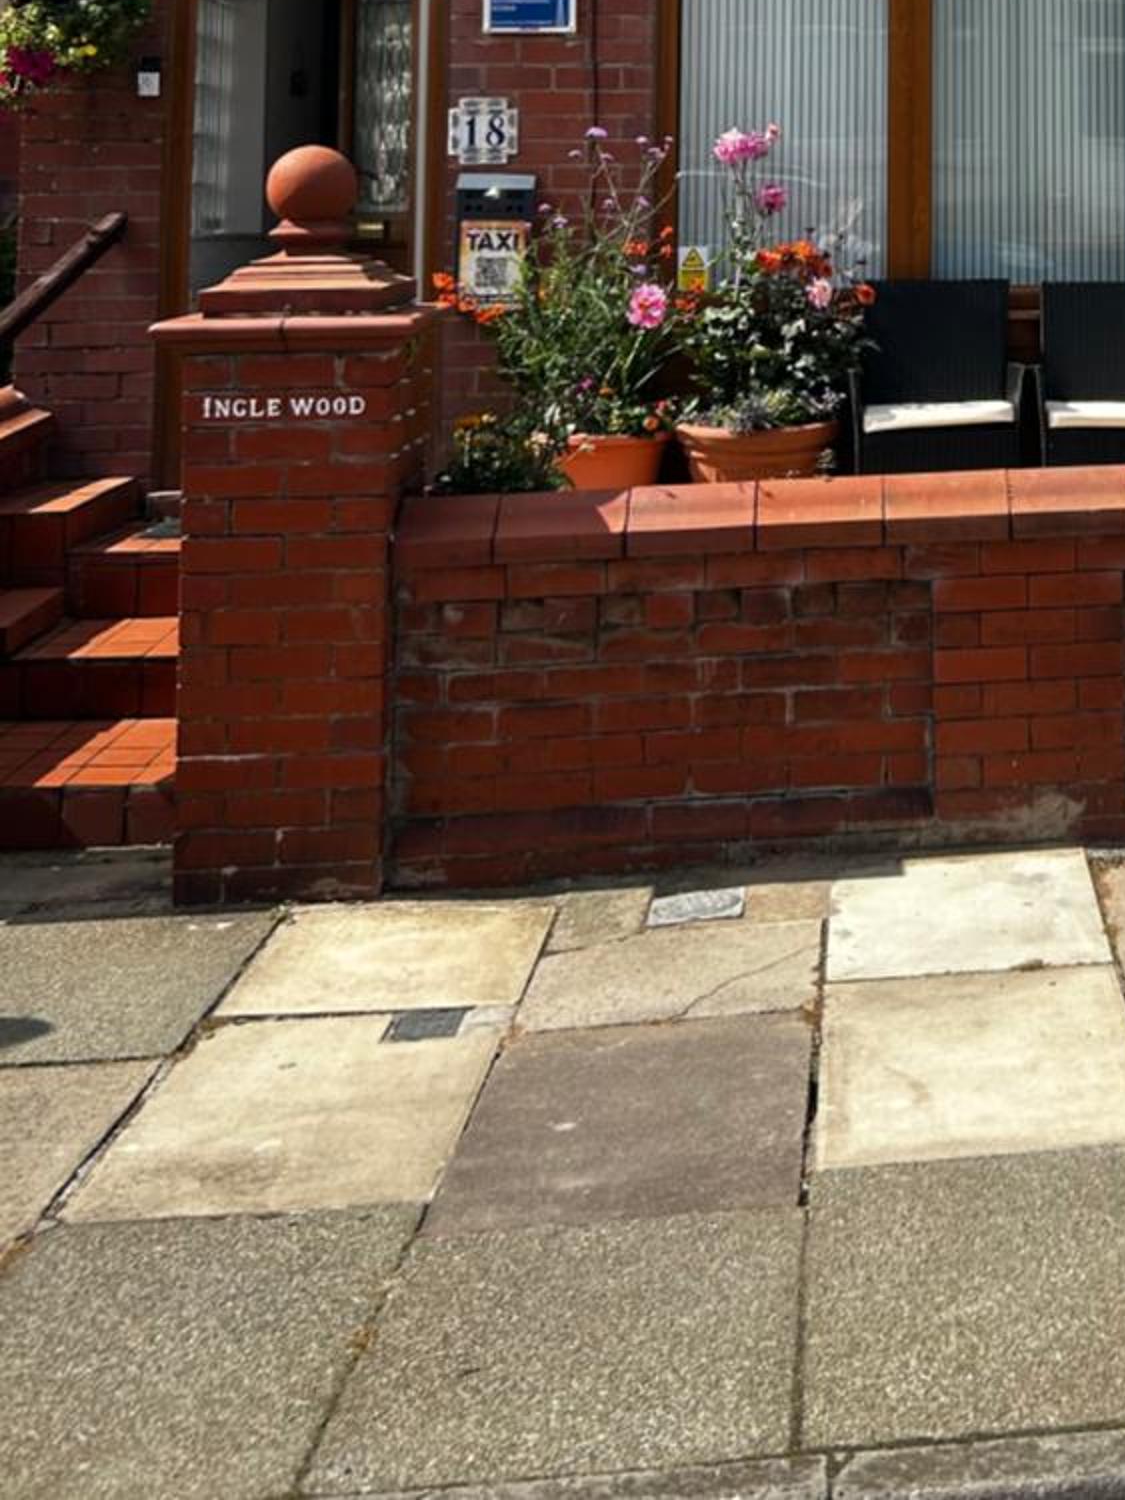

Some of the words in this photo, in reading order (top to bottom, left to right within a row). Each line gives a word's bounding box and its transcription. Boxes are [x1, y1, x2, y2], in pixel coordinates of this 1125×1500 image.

[465, 115, 506, 147] 18
[467, 231, 519, 251] TAXI
[203, 397, 281, 418] INGLE
[290, 395, 366, 416] WOOD
